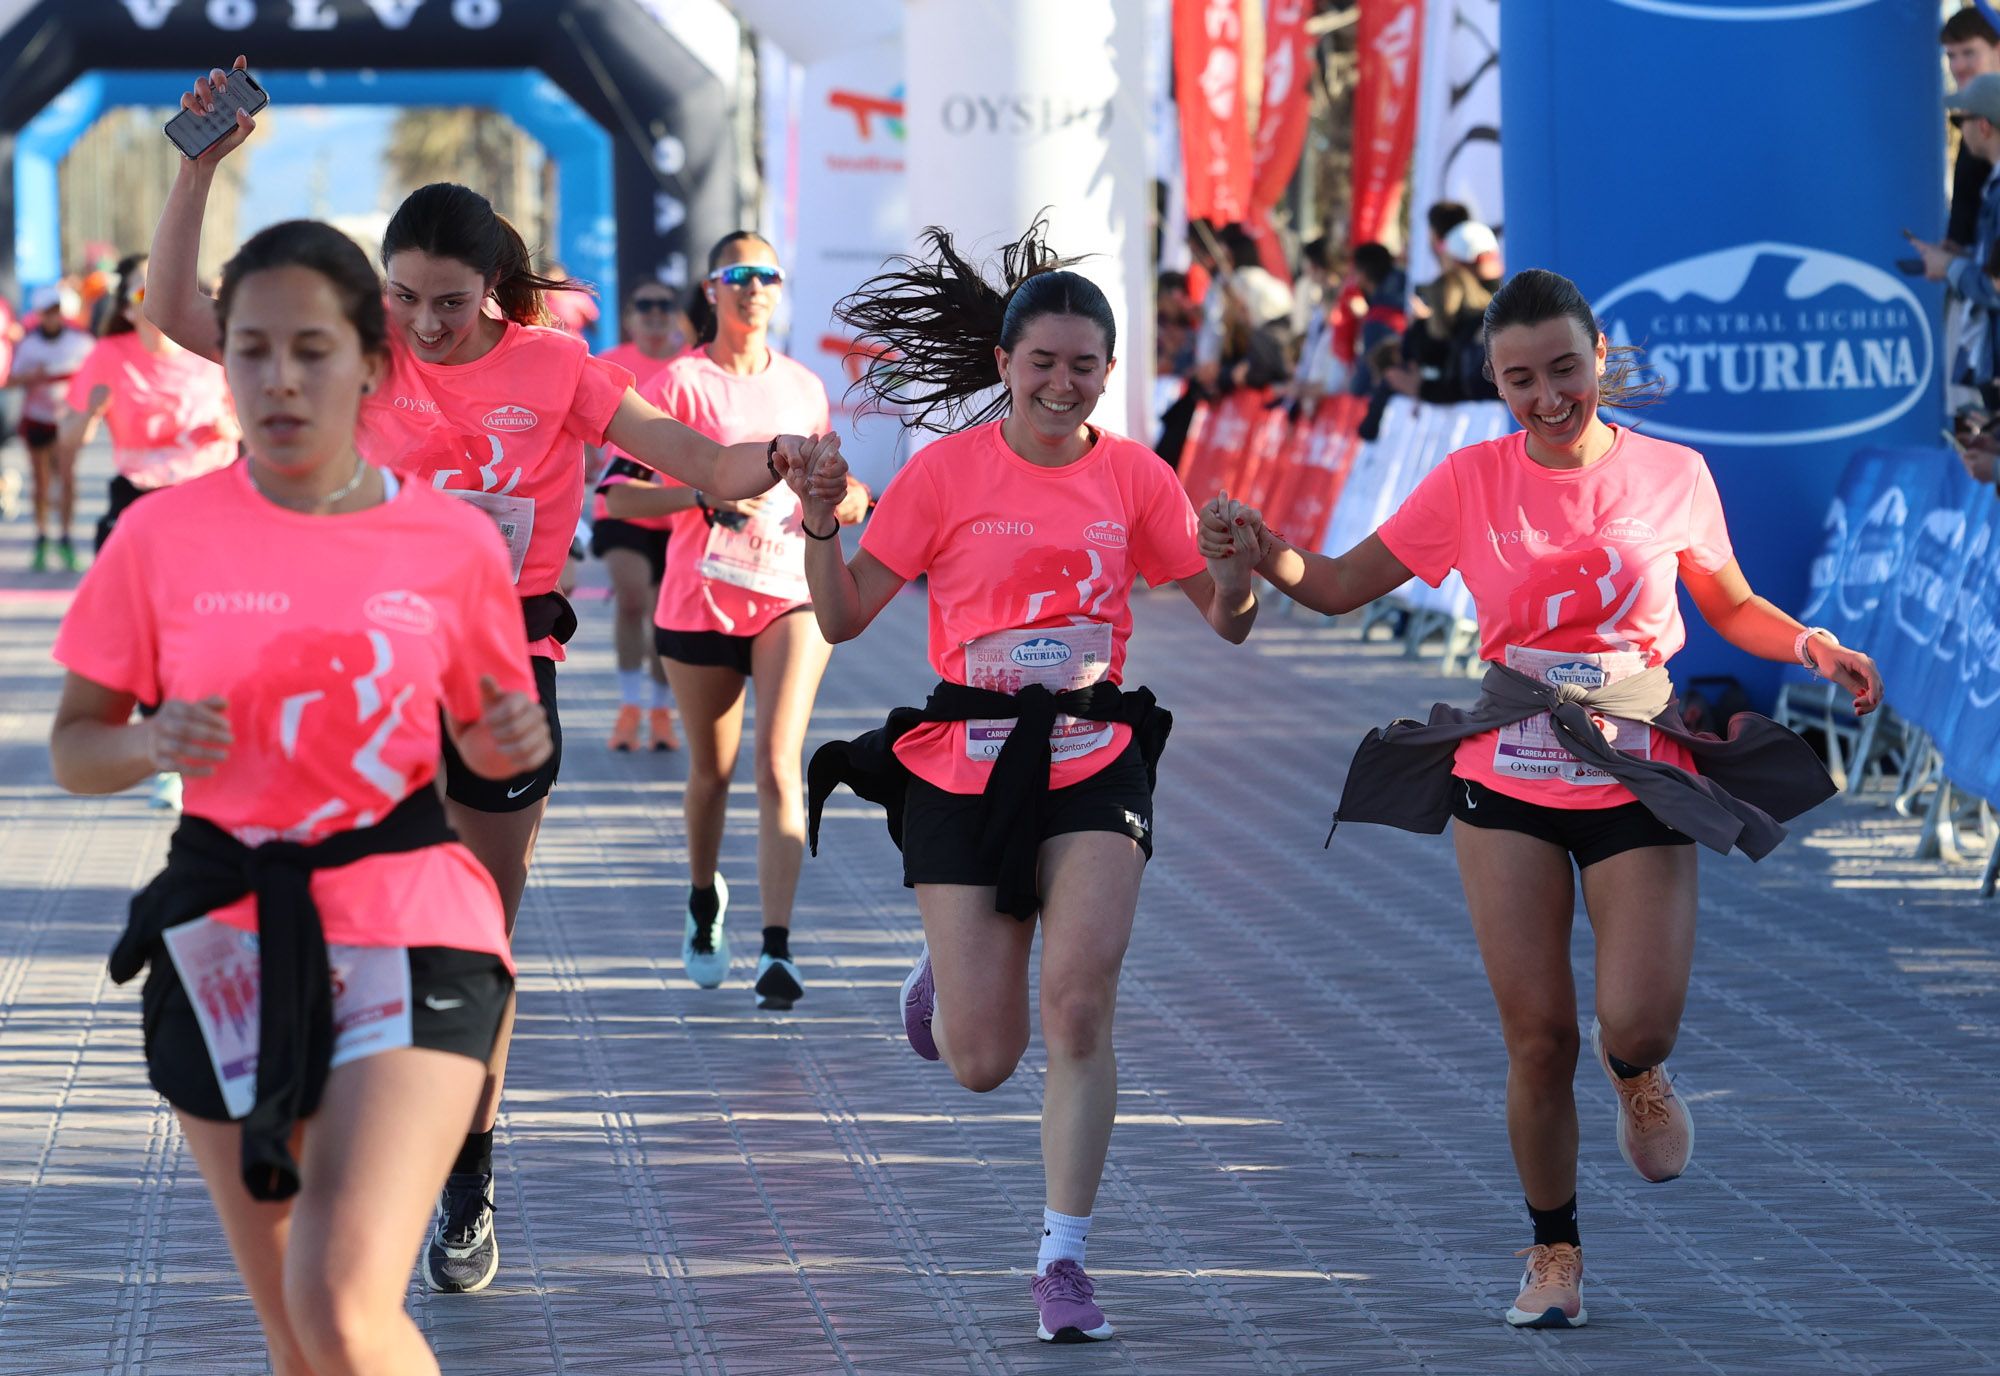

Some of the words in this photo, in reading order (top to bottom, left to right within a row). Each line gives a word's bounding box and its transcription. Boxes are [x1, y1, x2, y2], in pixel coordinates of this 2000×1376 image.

[122, 0, 502, 31] VOLVO
[1650, 310, 1786, 336] CENTRAL
[1603, 318, 1917, 395] ASTURIANA
[487, 415, 534, 426] ASTURIANA
[972, 521, 1034, 536] OYSHO
[1088, 529, 1127, 545] ASTURIAN
[1487, 529, 1549, 544] OYSHO
[193, 591, 290, 616] OYSHO
[977, 653, 1005, 663] SUMA
[1015, 649, 1068, 661] ASTURIANA
[1550, 670, 1602, 684] ASTURIANA
[986, 730, 1011, 738] CARRE
[1060, 739, 1098, 752] Santander
[1516, 748, 1547, 758] CARRERA
[1548, 751, 1557, 759] DE
[1558, 752, 1567, 760] LA
[1510, 761, 1559, 774] OYSHO
[1124, 810, 1149, 831] FILA
